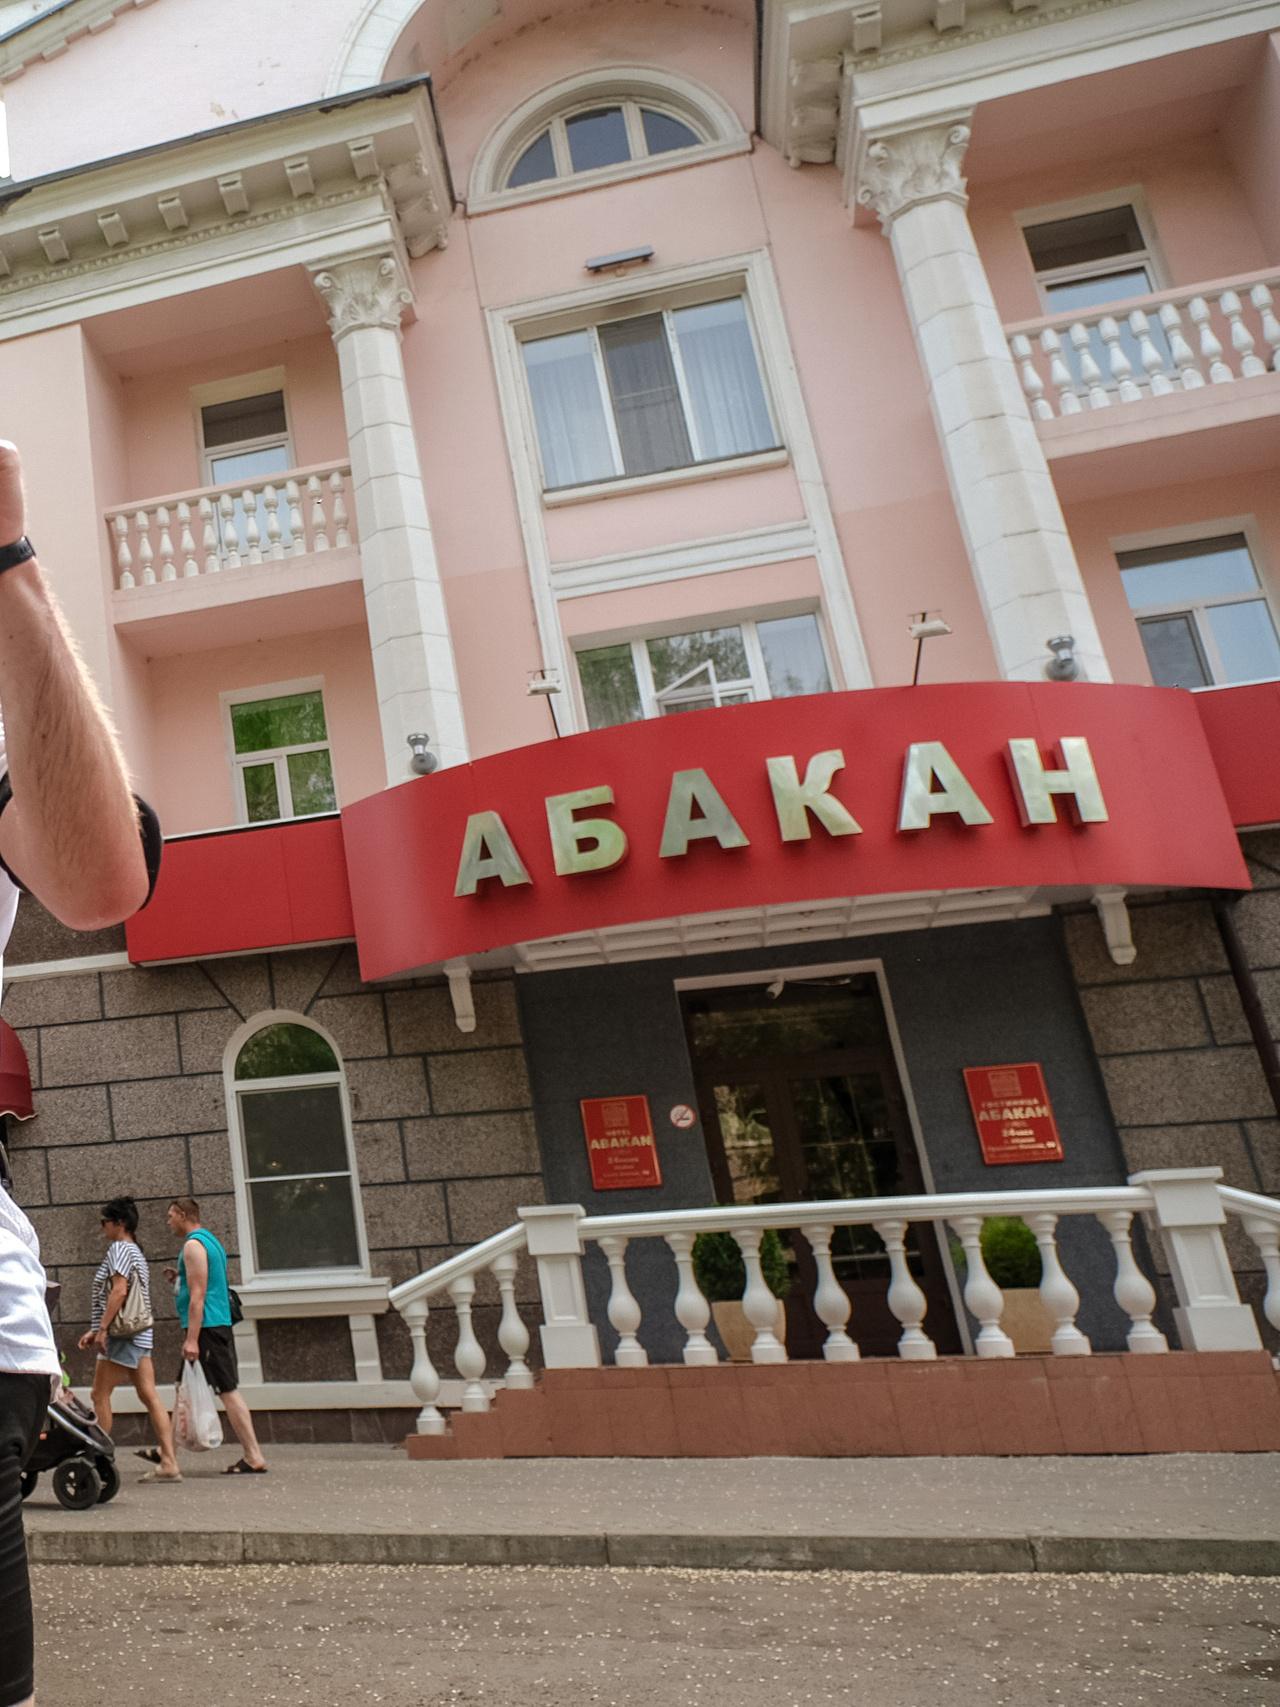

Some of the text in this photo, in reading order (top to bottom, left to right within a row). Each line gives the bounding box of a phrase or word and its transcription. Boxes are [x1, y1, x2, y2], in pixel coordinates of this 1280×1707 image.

[454, 736, 1109, 898] АБАКАН
[978, 1105, 1050, 1122] АБАКАН
[591, 1135, 653, 1150] ABAKAN
